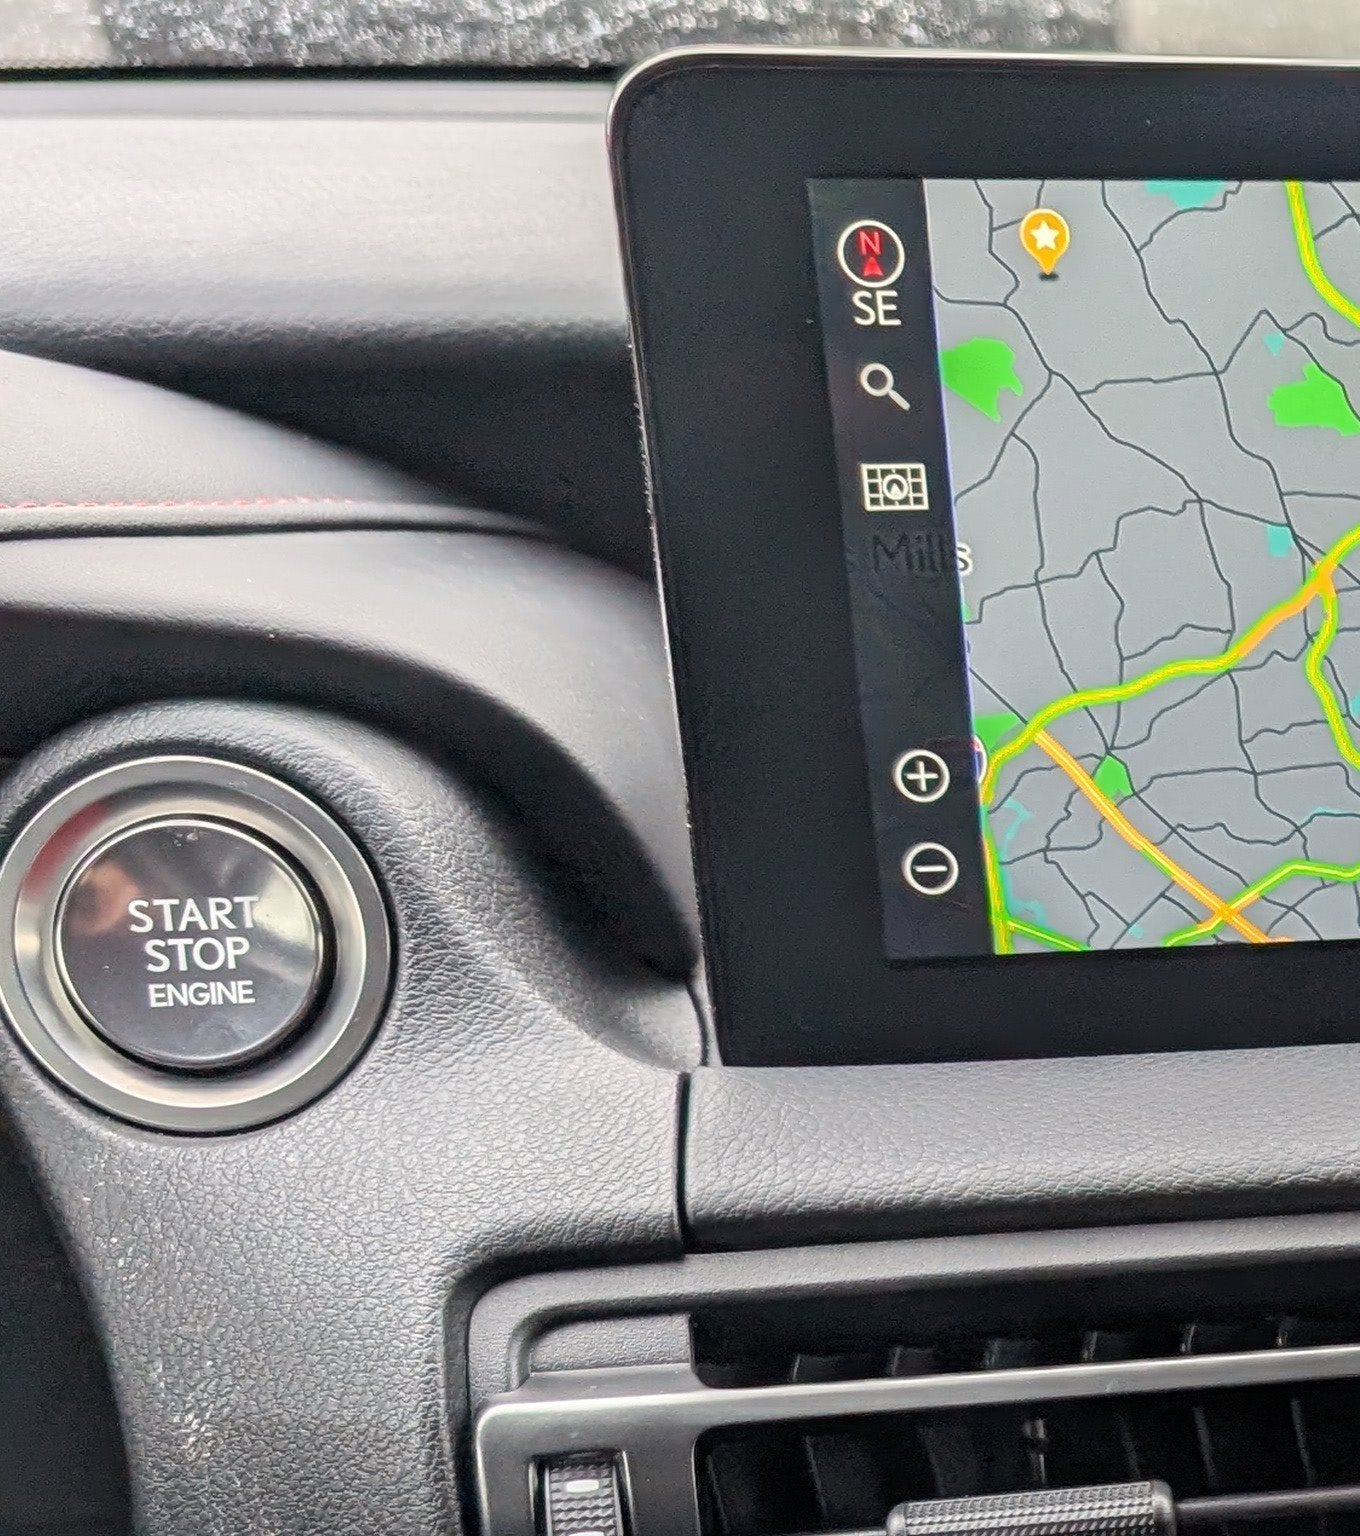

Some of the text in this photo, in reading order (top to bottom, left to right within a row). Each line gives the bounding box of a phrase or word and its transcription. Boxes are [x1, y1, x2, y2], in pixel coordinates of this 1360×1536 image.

[858, 229, 882, 256] N
[852, 289, 902, 326] SE
[128, 895, 260, 933] START
[144, 936, 250, 973] STOP
[148, 979, 256, 1008] ENGINE
